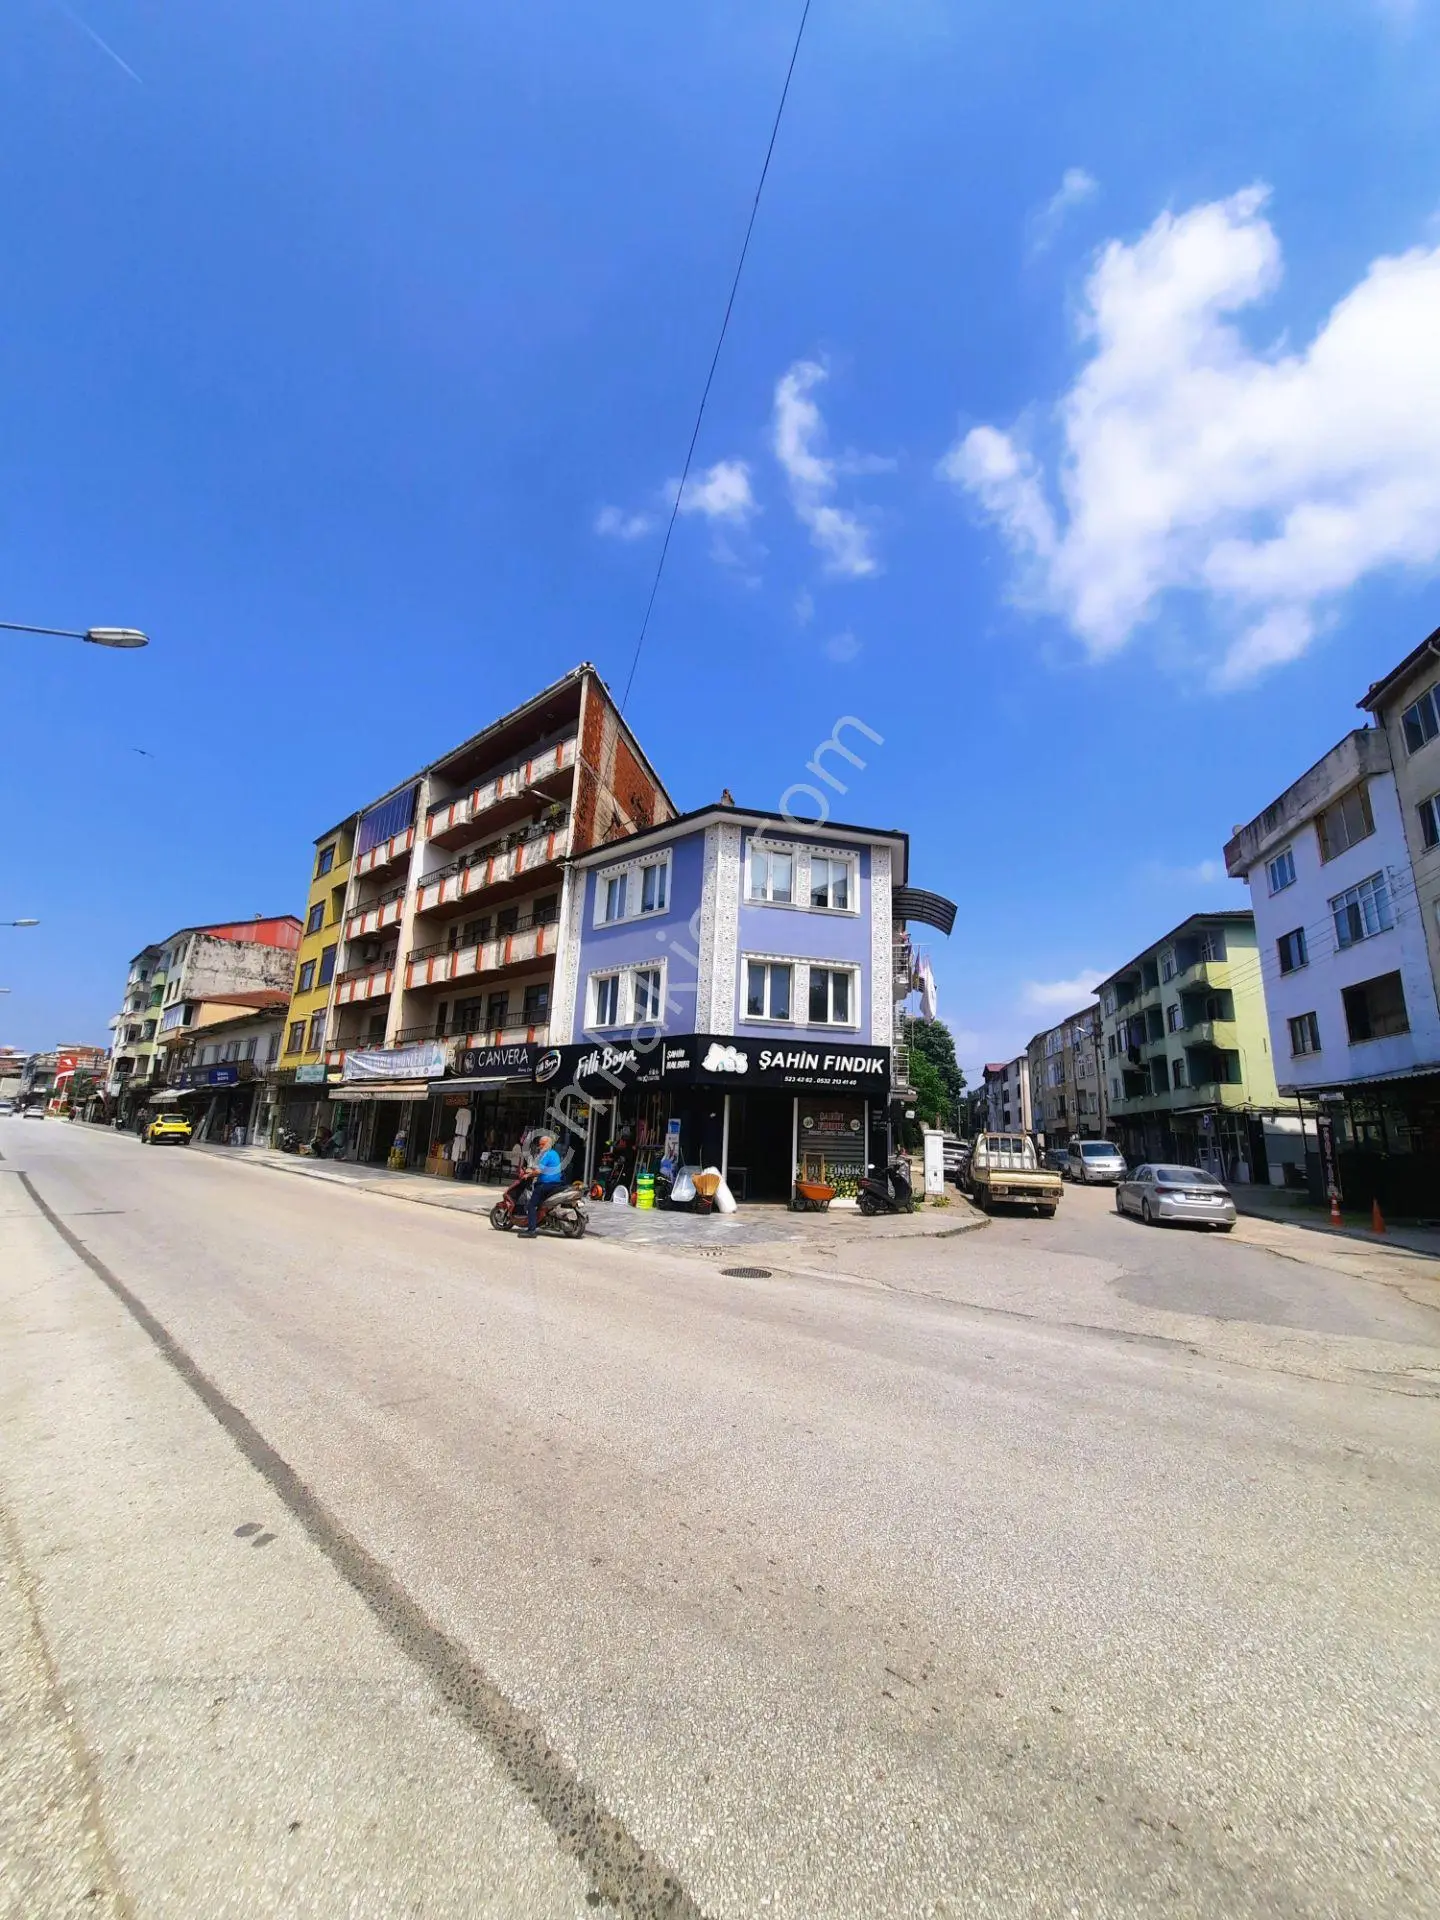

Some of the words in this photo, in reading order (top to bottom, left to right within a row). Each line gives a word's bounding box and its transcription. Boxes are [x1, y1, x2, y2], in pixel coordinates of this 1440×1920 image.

[478, 1048, 529, 1067] CANVERA
[544, 1059, 557, 1071] Boya
[576, 1050, 600, 1080] Filli
[602, 1047, 637, 1075] Boya
[758, 1050, 819, 1071] ŞAHİN
[823, 1055, 884, 1075] FINDIK
